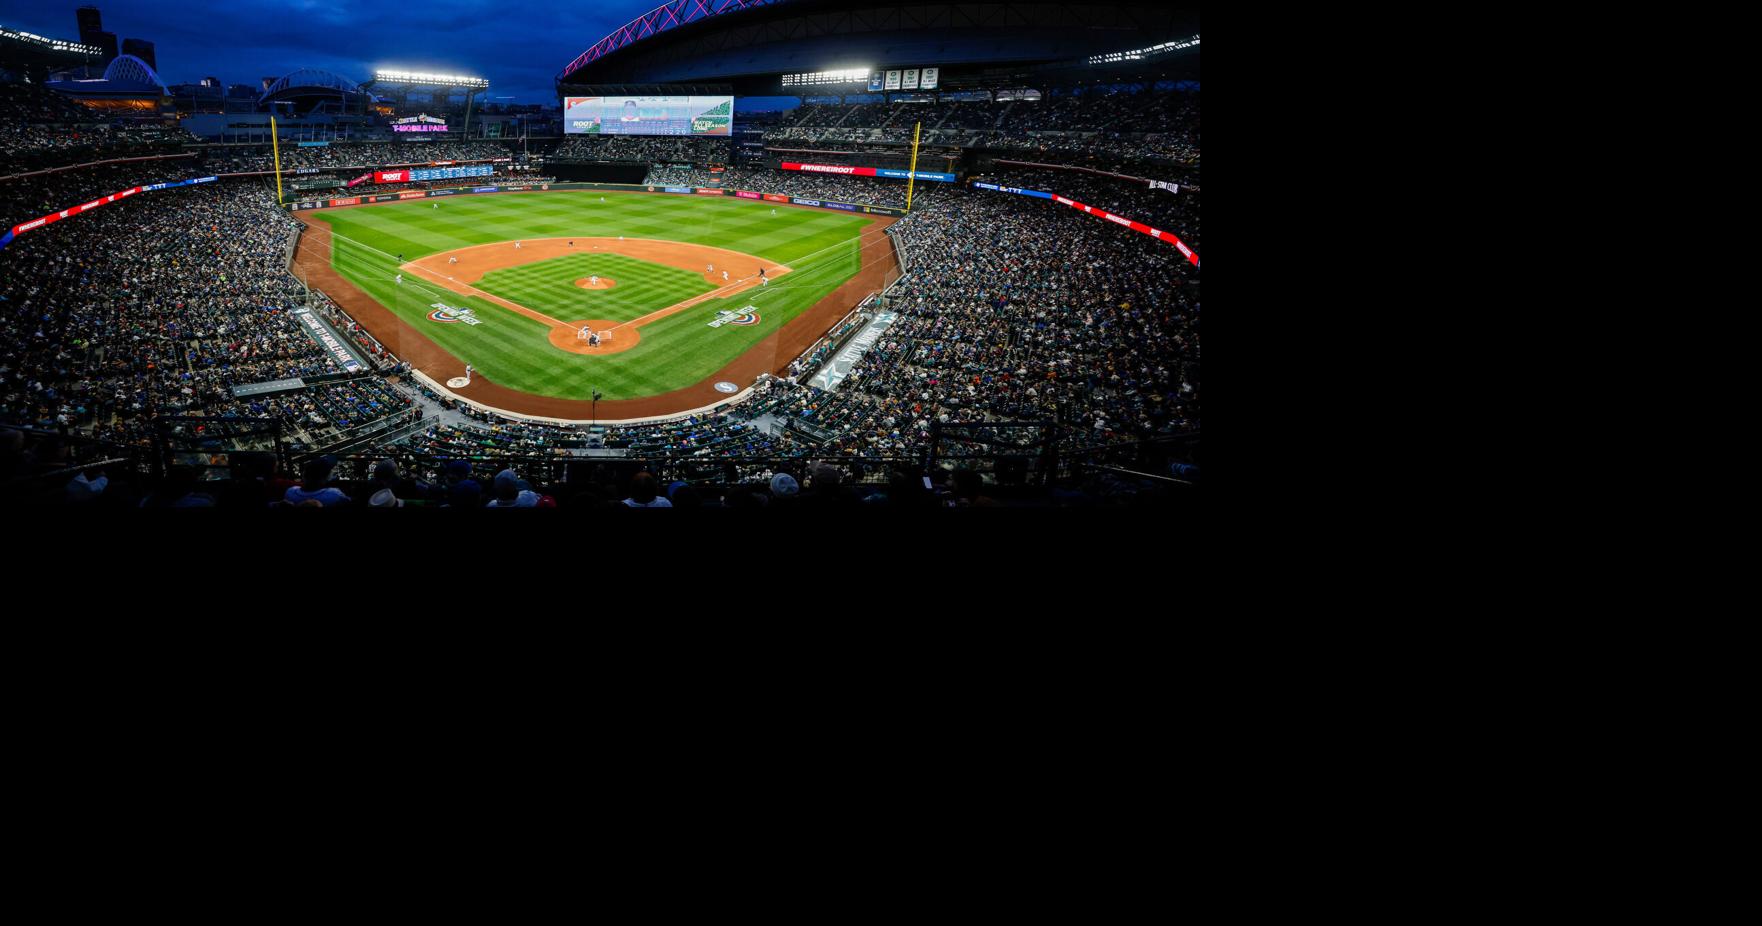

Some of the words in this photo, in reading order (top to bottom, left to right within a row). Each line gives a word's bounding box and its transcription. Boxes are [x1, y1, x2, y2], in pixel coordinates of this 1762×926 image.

[393, 124, 429, 132] T-MOBILE
[429, 124, 449, 132] PARK
[800, 164, 855, 174] #WHEREIROOT
[793, 198, 820, 206] GEICO
